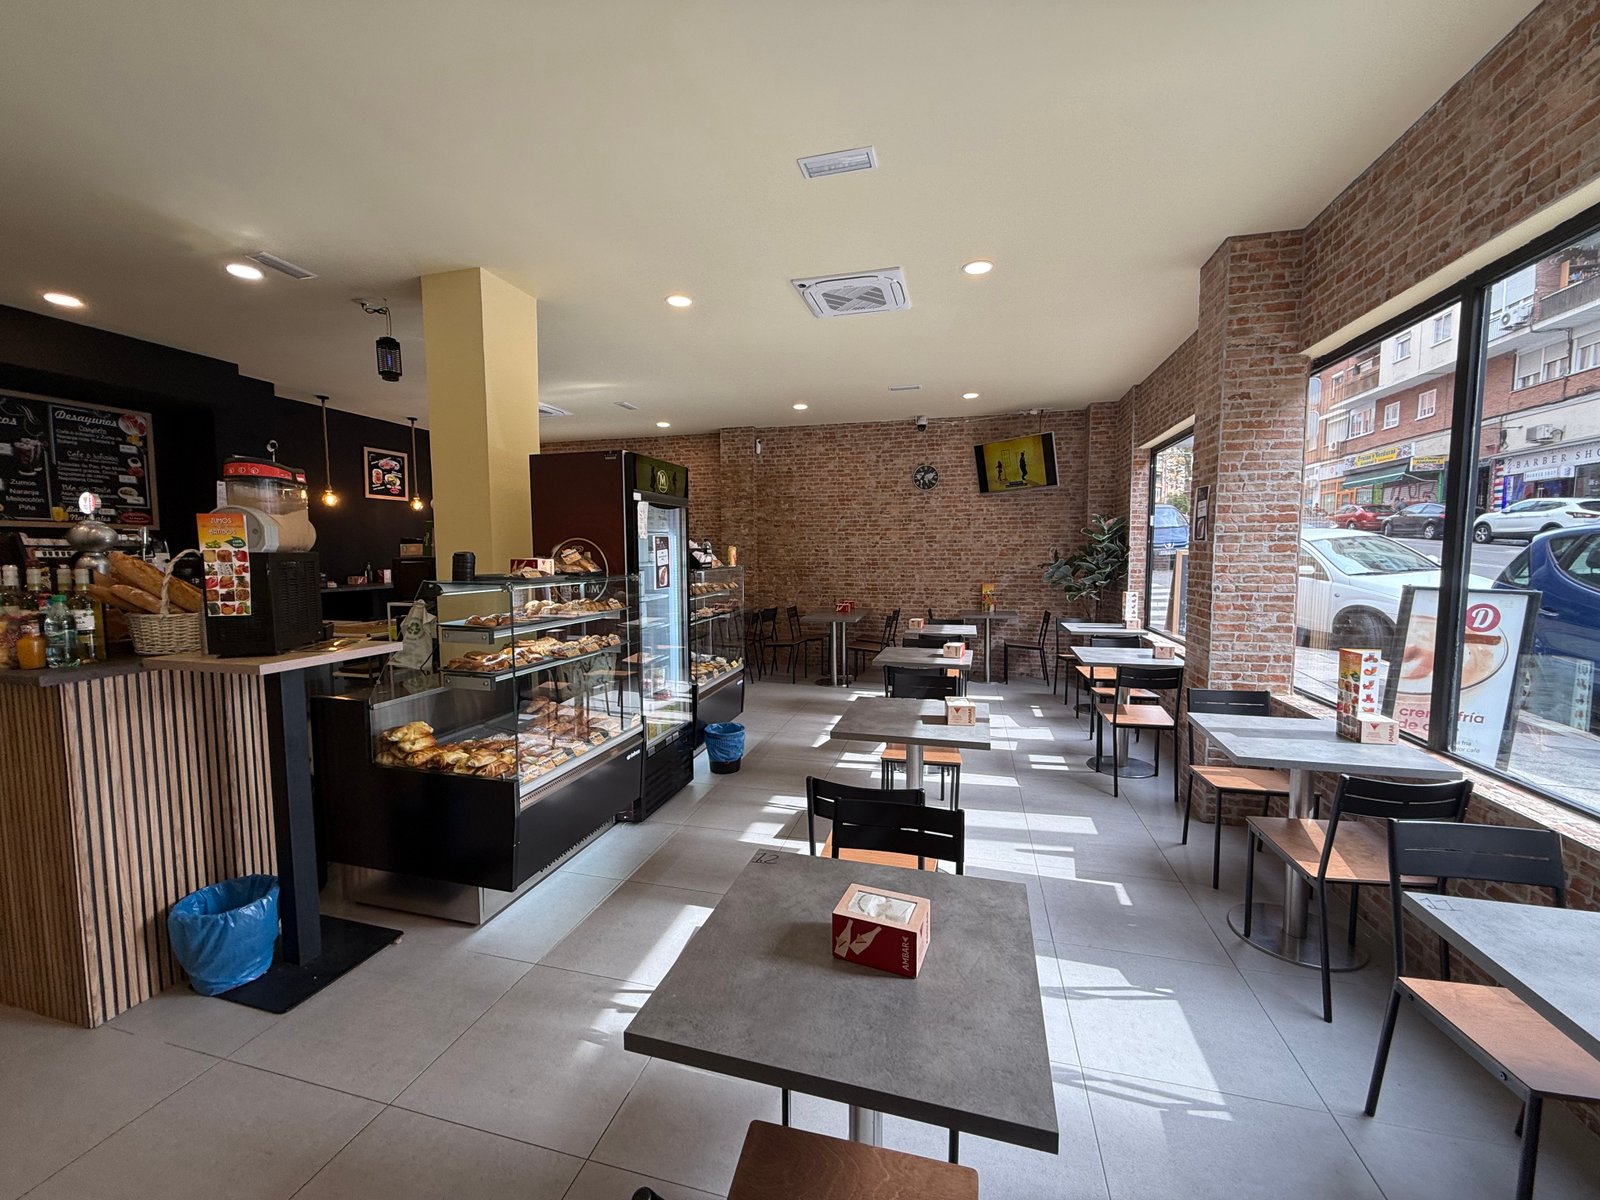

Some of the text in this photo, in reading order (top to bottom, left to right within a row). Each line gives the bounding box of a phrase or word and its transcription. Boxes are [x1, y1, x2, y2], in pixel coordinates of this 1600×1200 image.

[54, 410, 119, 427] Desayunos
[1515, 453, 1567, 469] BARBER
[9, 488, 40, 496] Naranja
[560, 584, 600, 594] MAGUM
[1471, 608, 1495, 628] D
[1457, 711, 1485, 724] fría
[901, 942, 910, 971] AMBAR
